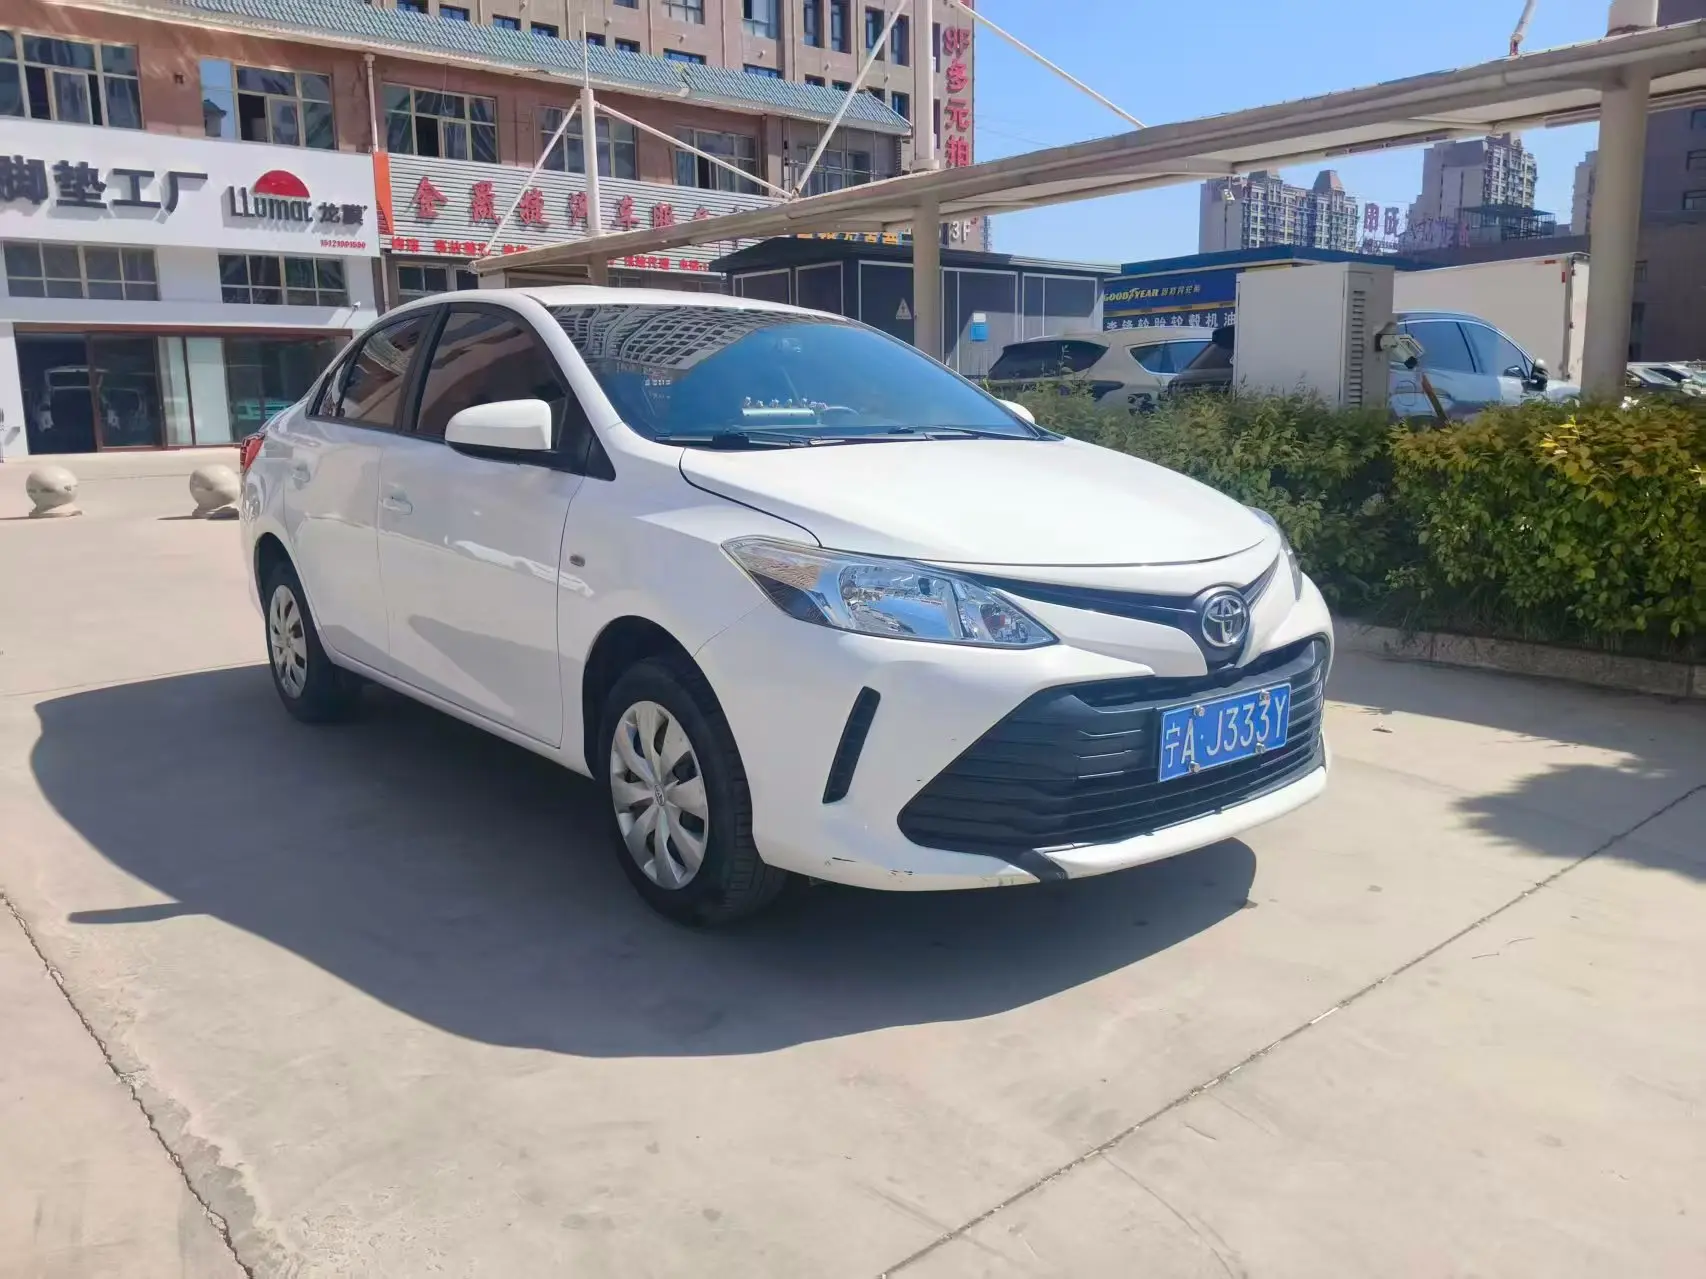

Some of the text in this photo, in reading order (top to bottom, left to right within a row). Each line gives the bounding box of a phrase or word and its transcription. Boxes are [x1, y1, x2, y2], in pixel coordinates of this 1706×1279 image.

[0, 155, 208, 216] 脚垫工厂
[1103, 286, 1159, 302] GOODYEAR
